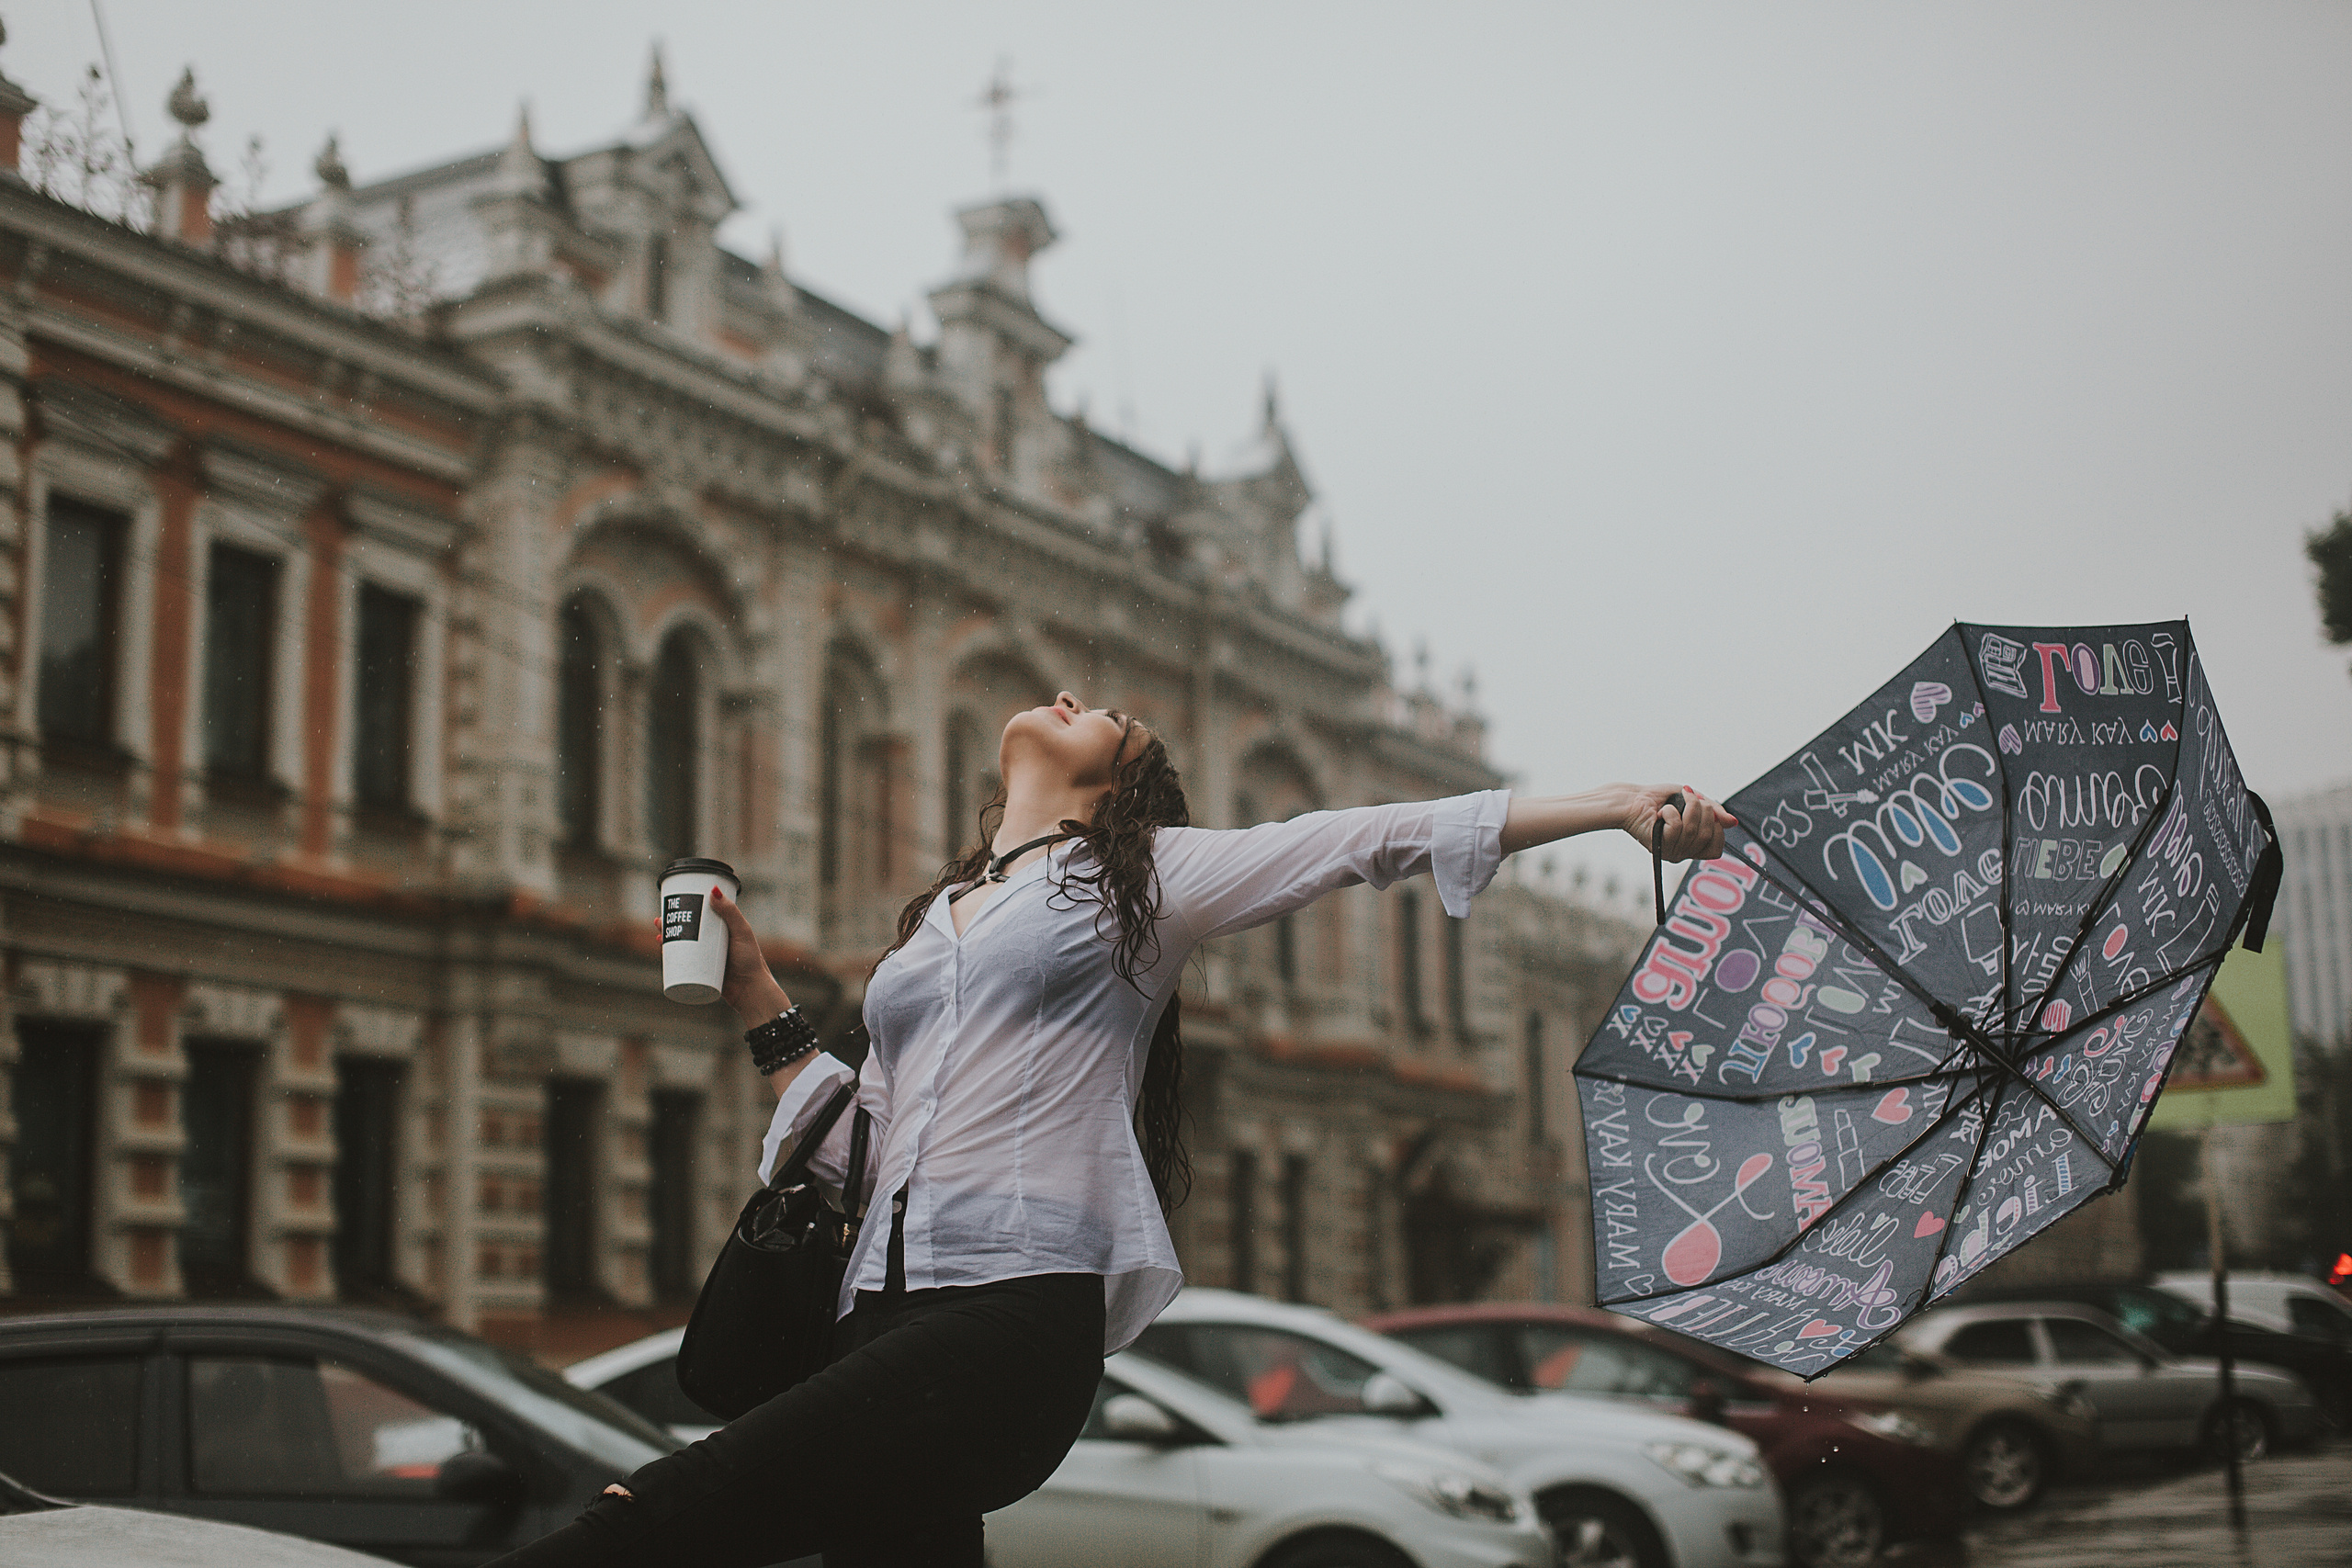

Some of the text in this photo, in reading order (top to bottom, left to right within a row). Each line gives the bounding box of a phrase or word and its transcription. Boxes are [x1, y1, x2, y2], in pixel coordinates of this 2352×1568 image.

[667, 897, 681, 910] THE
[666, 911, 692, 924] COFFEE
[665, 925, 683, 939] SHOP
